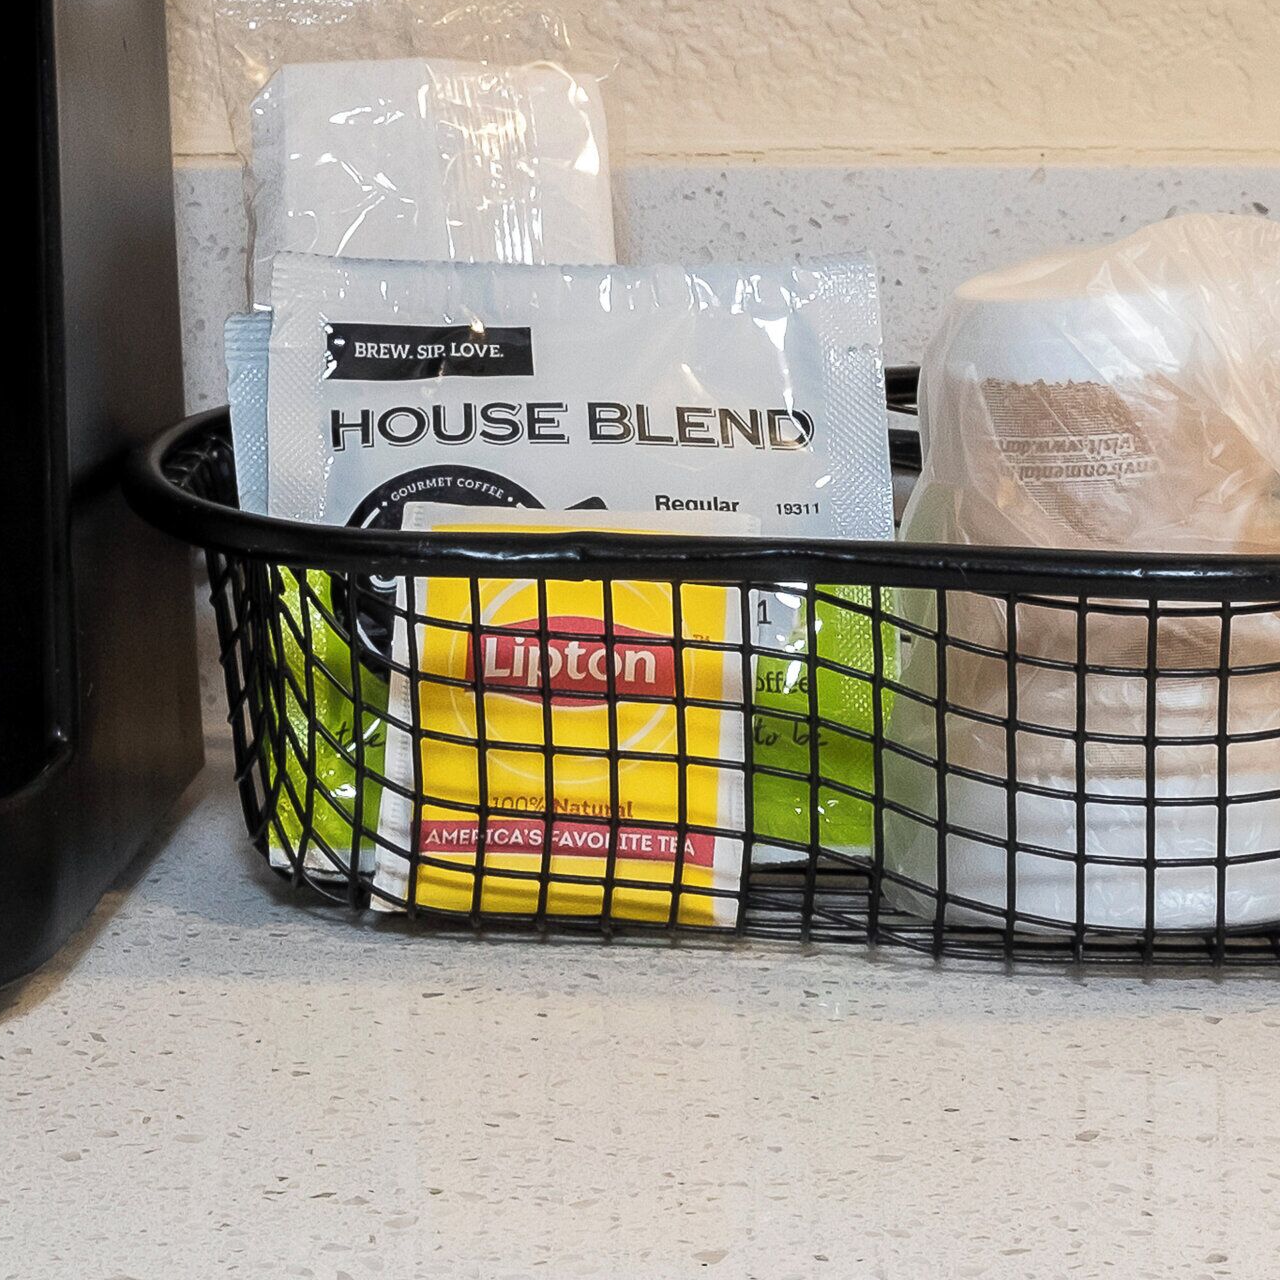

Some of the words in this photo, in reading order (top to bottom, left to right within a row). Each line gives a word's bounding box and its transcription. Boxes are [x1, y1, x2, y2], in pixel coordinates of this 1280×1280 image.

[354, 342, 413, 360] BREW.
[416, 344, 447, 360] SIP.
[450, 342, 504, 358] LOVE.
[329, 401, 569, 451] HOUSE
[586, 401, 815, 452] BLEND
[391, 477, 453, 502] GOURMET
[456, 478, 505, 500] COFFEE
[776, 502, 820, 516] 19311
[483, 637, 656, 687] Lipton
[754, 718, 780, 746] to
